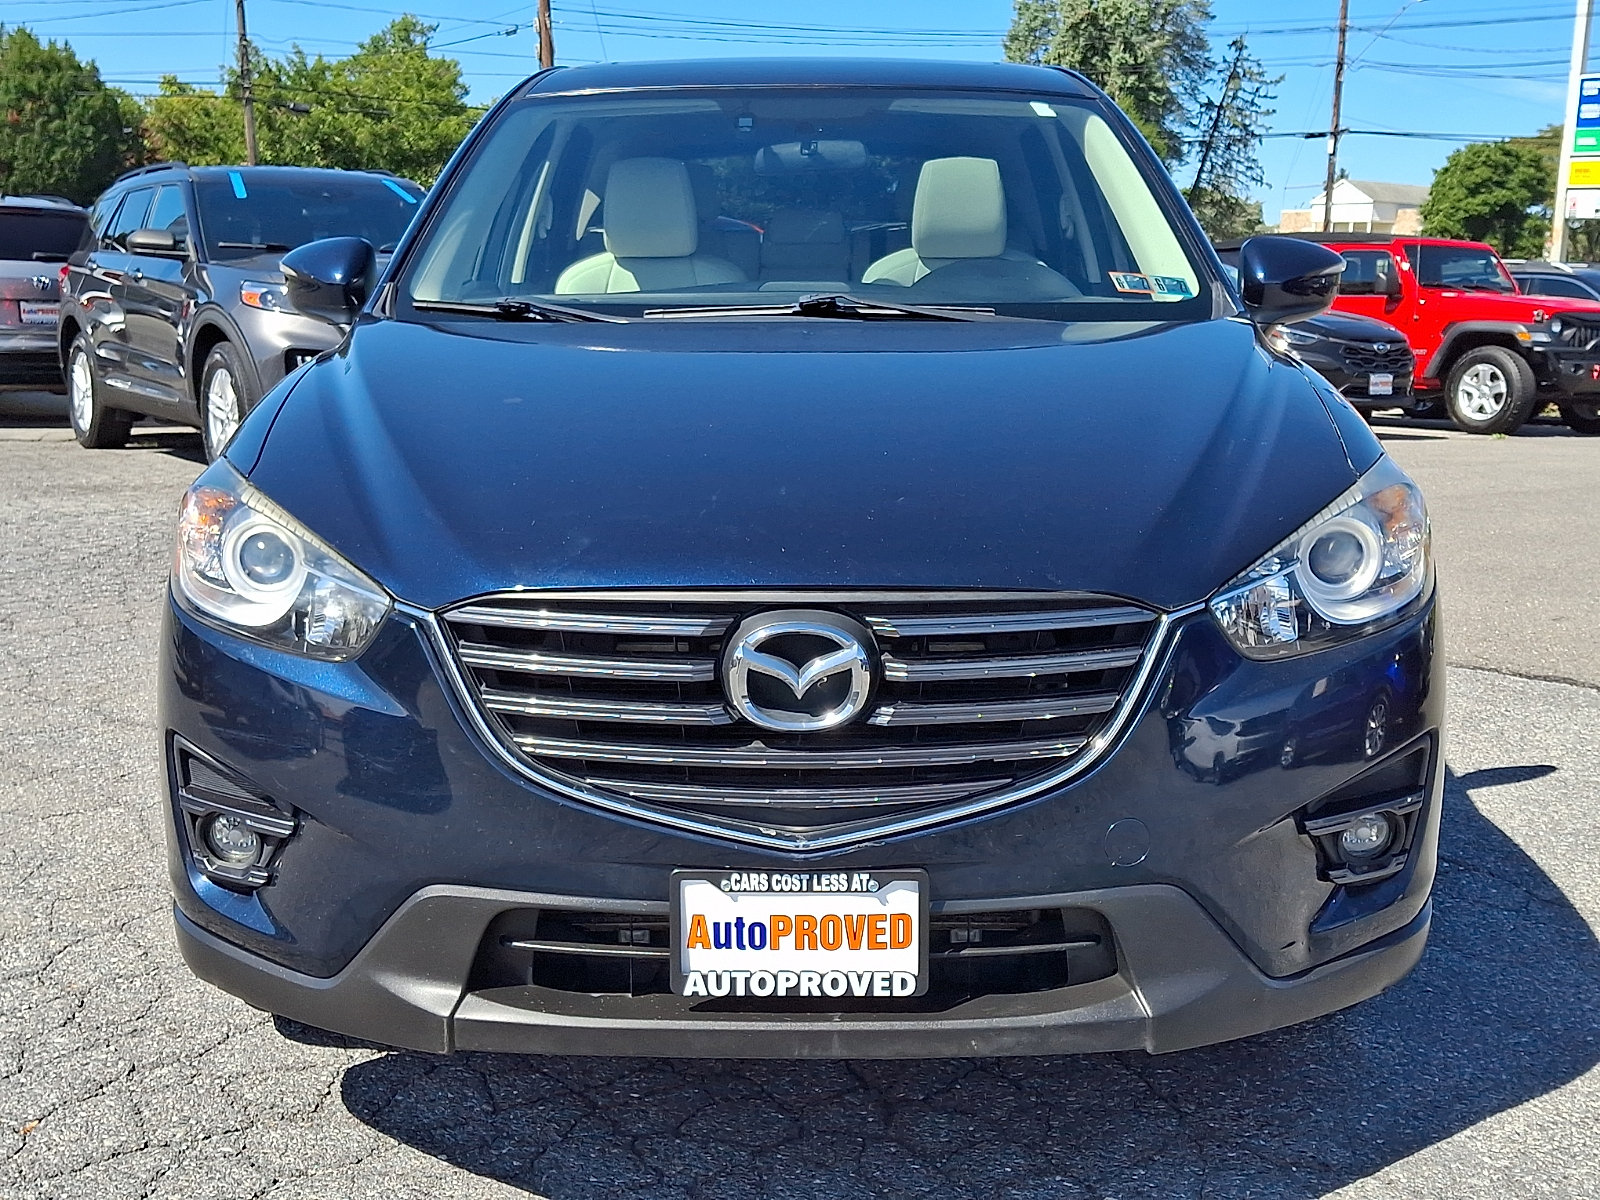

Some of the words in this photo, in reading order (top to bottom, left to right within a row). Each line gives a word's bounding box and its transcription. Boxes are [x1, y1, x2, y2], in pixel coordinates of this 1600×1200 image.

[730, 873, 768, 892] CARS
[772, 873, 810, 891] COST
[812, 873, 848, 891] LESS
[851, 873, 870, 891] AT
[687, 913, 912, 951] AutoPROVED
[683, 970, 916, 997] AUTOPROVED
